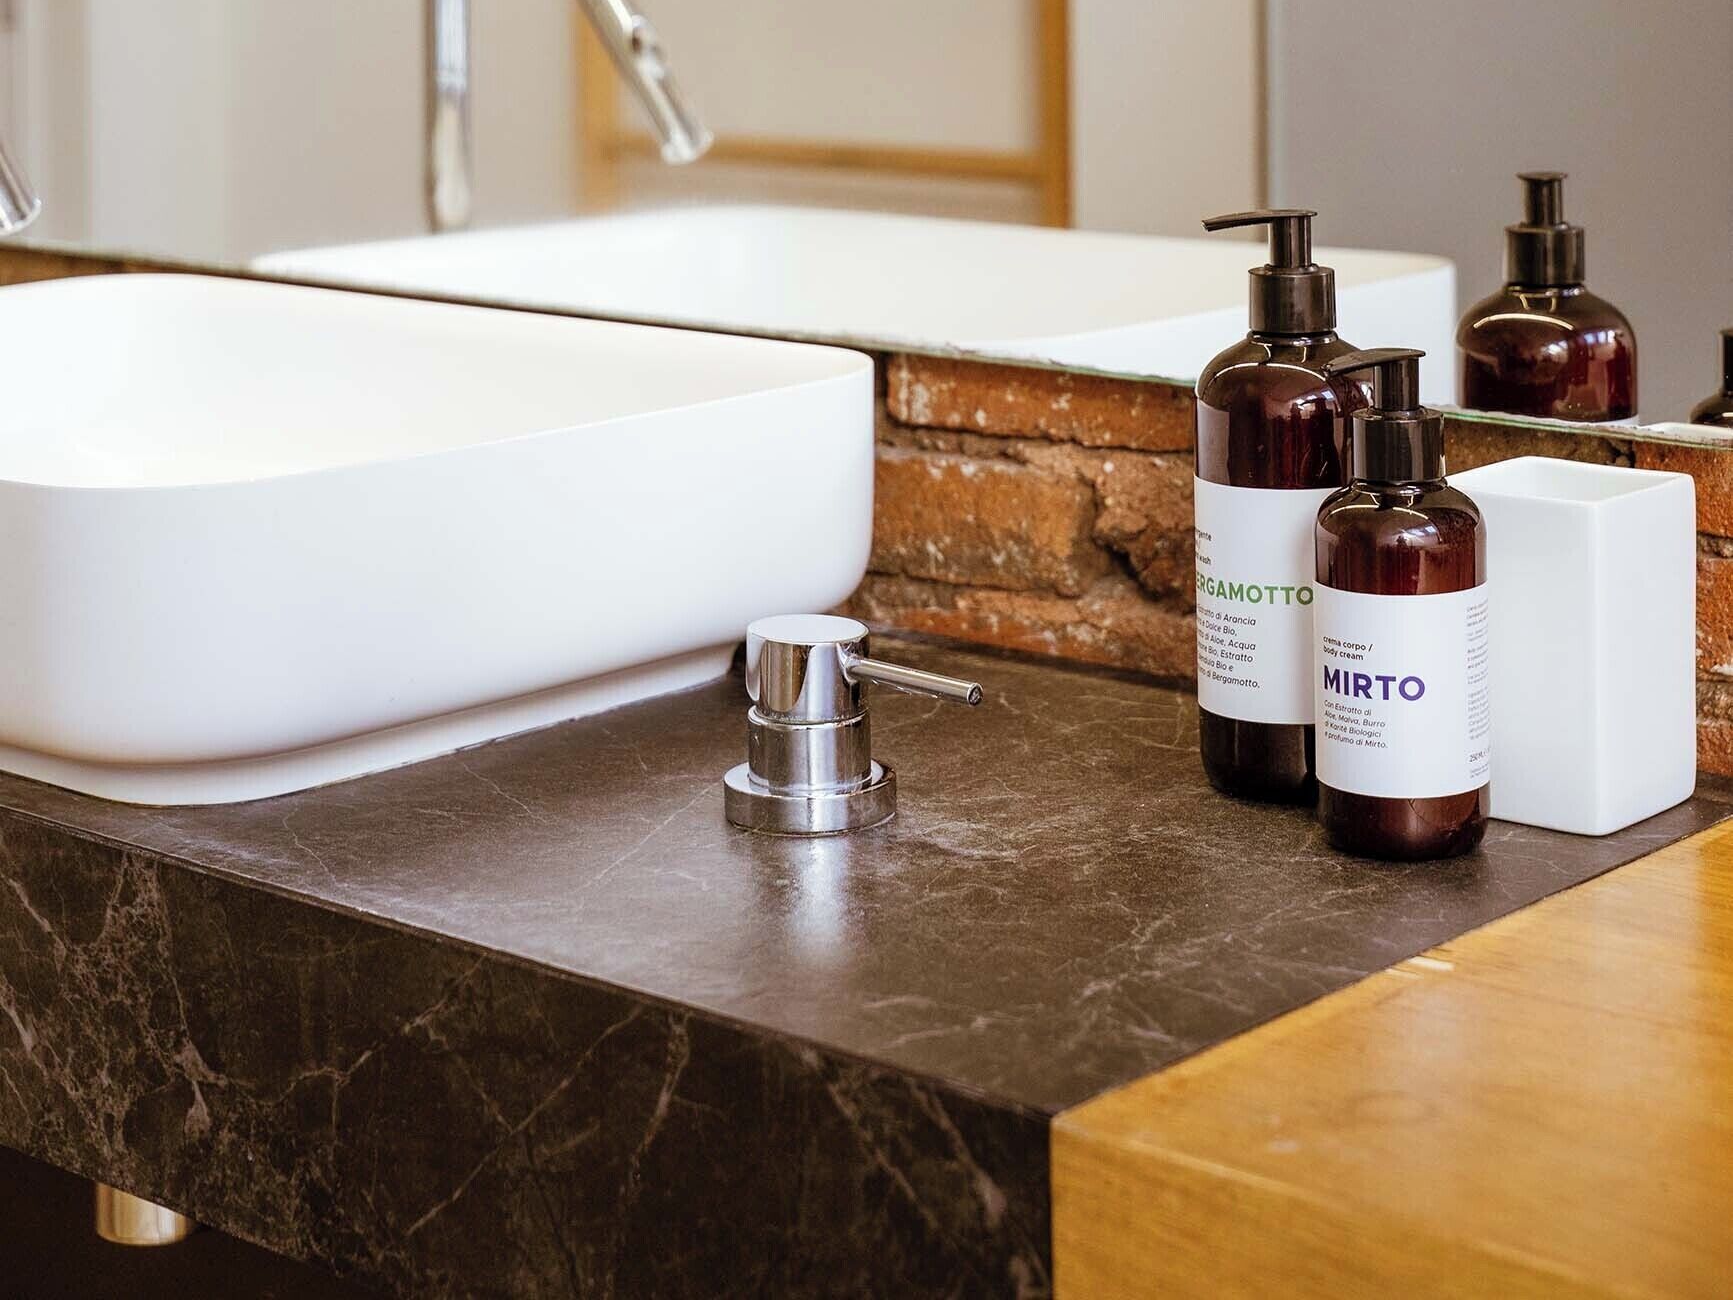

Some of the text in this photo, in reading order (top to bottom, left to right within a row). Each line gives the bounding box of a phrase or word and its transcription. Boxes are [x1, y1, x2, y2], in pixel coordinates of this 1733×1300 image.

[1196, 571, 1314, 606] ERGAMOTTO
[1223, 614, 1256, 626] Arancia
[1206, 620, 1221, 632] Dolce
[1223, 626, 1237, 636] Bio,
[1228, 640, 1256, 651] Acqua
[1323, 636, 1341, 647] crema
[1343, 641, 1367, 652] corpo
[1220, 649, 1254, 663] Estratto
[1323, 645, 1364, 660] body cream
[1216, 661, 1228, 671] Bio
[1228, 664, 1234, 672] e
[1212, 671, 1260, 689] Bergamotto.
[1324, 664, 1426, 702] MIRTO
[1324, 699, 1334, 708] Con
[1335, 703, 1362, 715] Estratto
[1339, 714, 1361, 725] Malva,
[1363, 718, 1386, 728] Burro
[1349, 726, 1381, 738] Biologici
[1328, 732, 1354, 744] profumo
[1356, 737, 1363, 745] di
[1365, 739, 1389, 749] Mirto.
